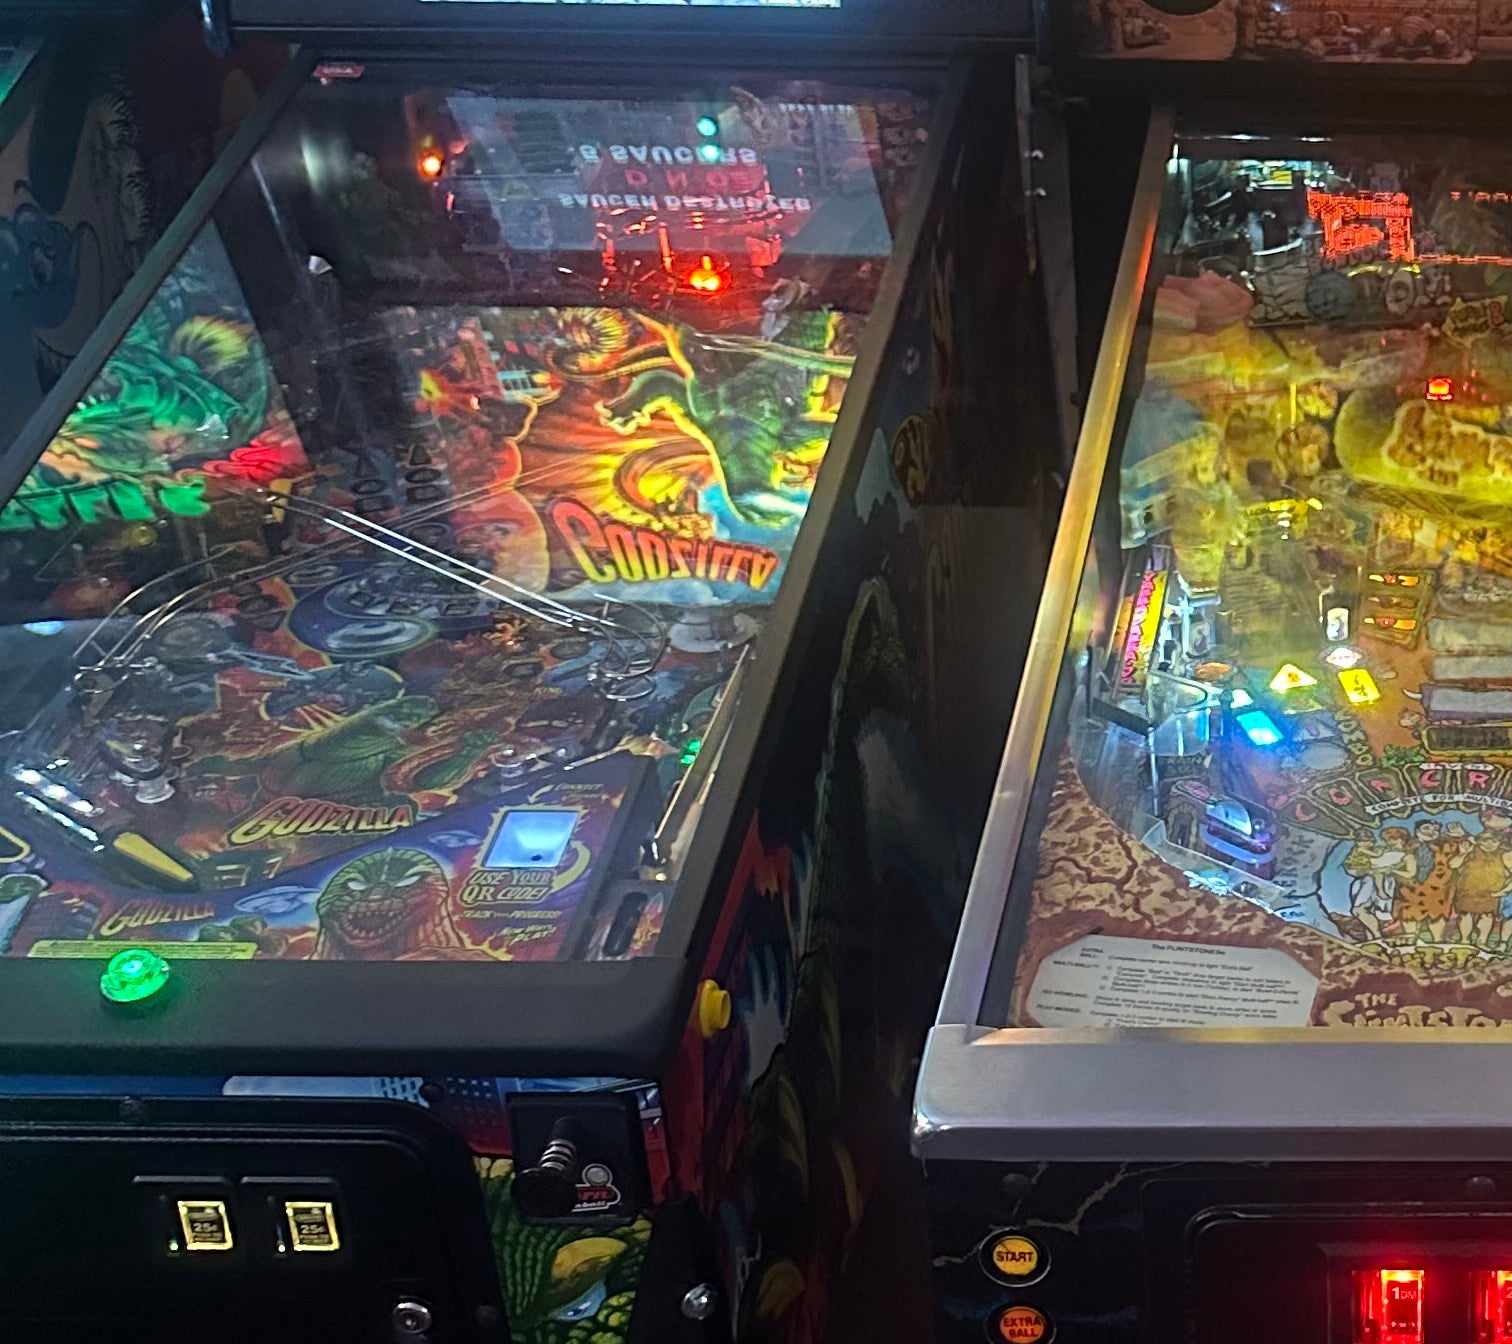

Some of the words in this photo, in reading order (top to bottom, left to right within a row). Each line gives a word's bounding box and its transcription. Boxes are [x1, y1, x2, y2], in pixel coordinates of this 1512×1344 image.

[228, 798, 412, 846] GODZILLA
[469, 871, 511, 885] USE
[512, 870, 551, 885] YOUR
[461, 885, 498, 905] QR
[99, 902, 216, 937] GODZILLA
[1354, 992, 1399, 1008] THE
[996, 1250, 1034, 1263] START
[1003, 1316, 1042, 1329] EXTRA
[1008, 1328, 1039, 1339] BALL
